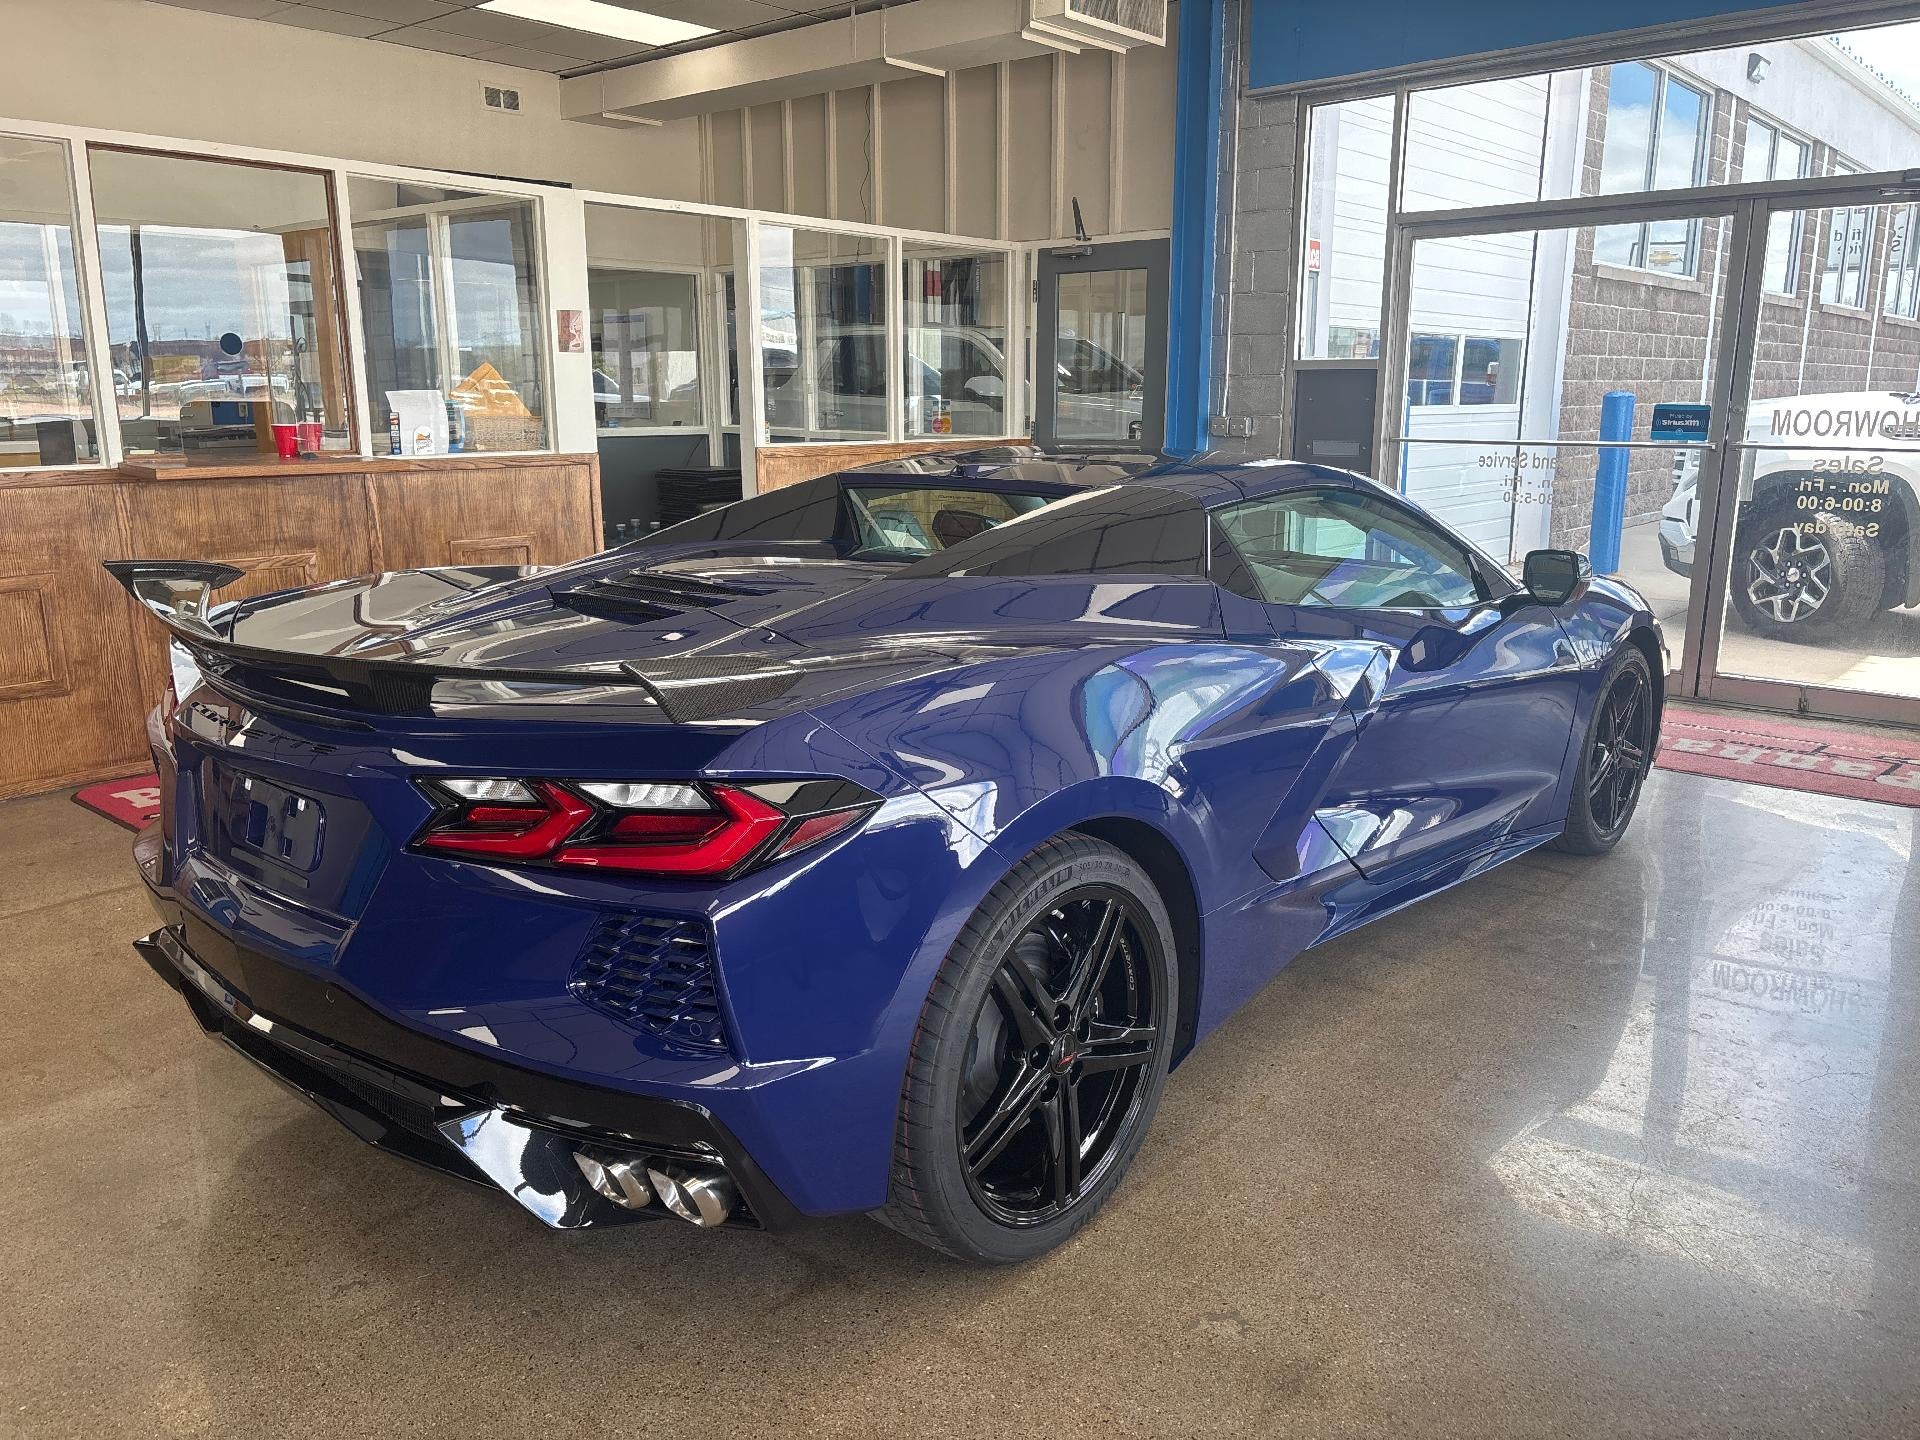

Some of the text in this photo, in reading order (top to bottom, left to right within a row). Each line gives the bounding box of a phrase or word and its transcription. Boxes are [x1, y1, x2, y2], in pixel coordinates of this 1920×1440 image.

[1662, 419, 1700, 427] SiriusXM
[1661, 734, 1920, 789] Panha
[1000, 865, 1073, 936] MICHELIN
